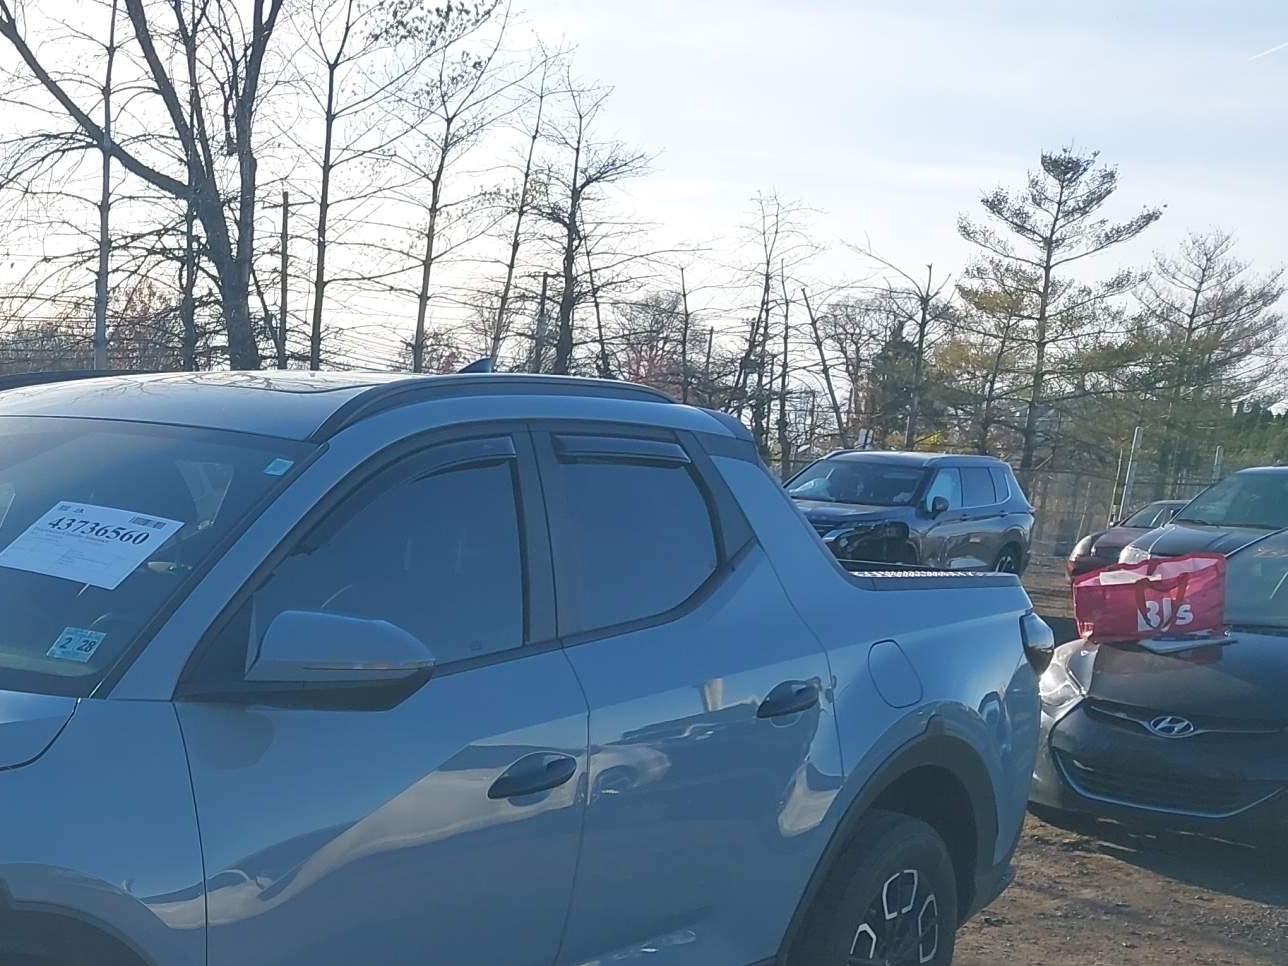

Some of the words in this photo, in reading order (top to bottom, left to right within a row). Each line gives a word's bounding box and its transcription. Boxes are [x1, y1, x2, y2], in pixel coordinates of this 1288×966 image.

[48, 517, 150, 545] 43736560
[59, 637, 72, 648] 2
[76, 640, 96, 652] 28
